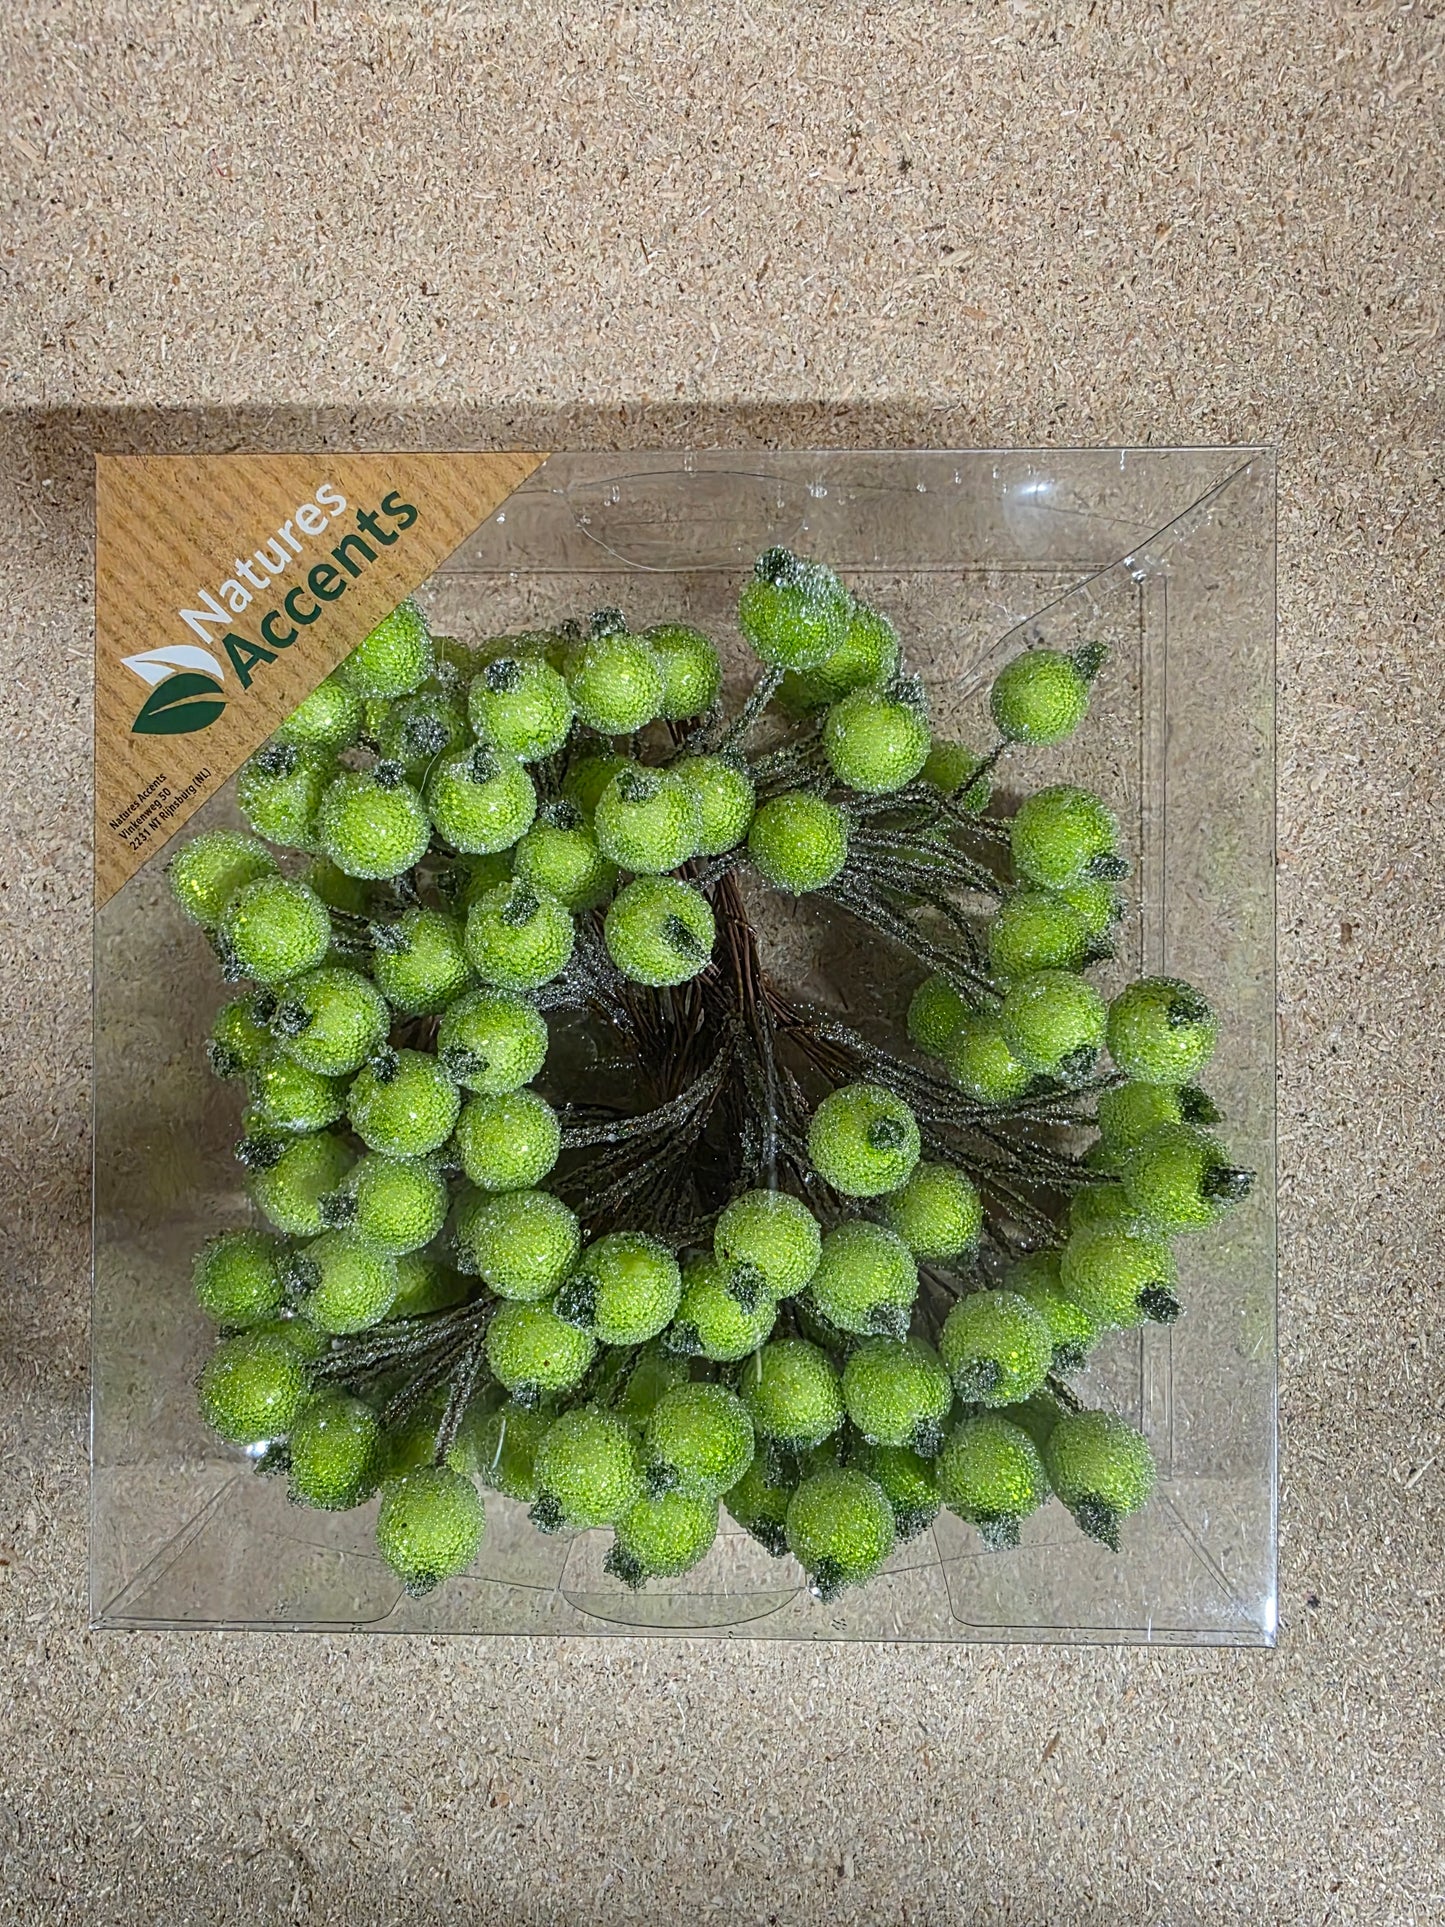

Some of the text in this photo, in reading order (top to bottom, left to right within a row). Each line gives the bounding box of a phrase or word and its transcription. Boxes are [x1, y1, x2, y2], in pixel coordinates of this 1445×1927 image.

[179, 483, 346, 644] Natures
[222, 490, 418, 689] Accents
[109, 773, 167, 830] Natures Accents
[119, 787, 171, 839] Vinkenweg 50
[130, 767, 211, 850] 2231 NT Rijnsburg (NL)
